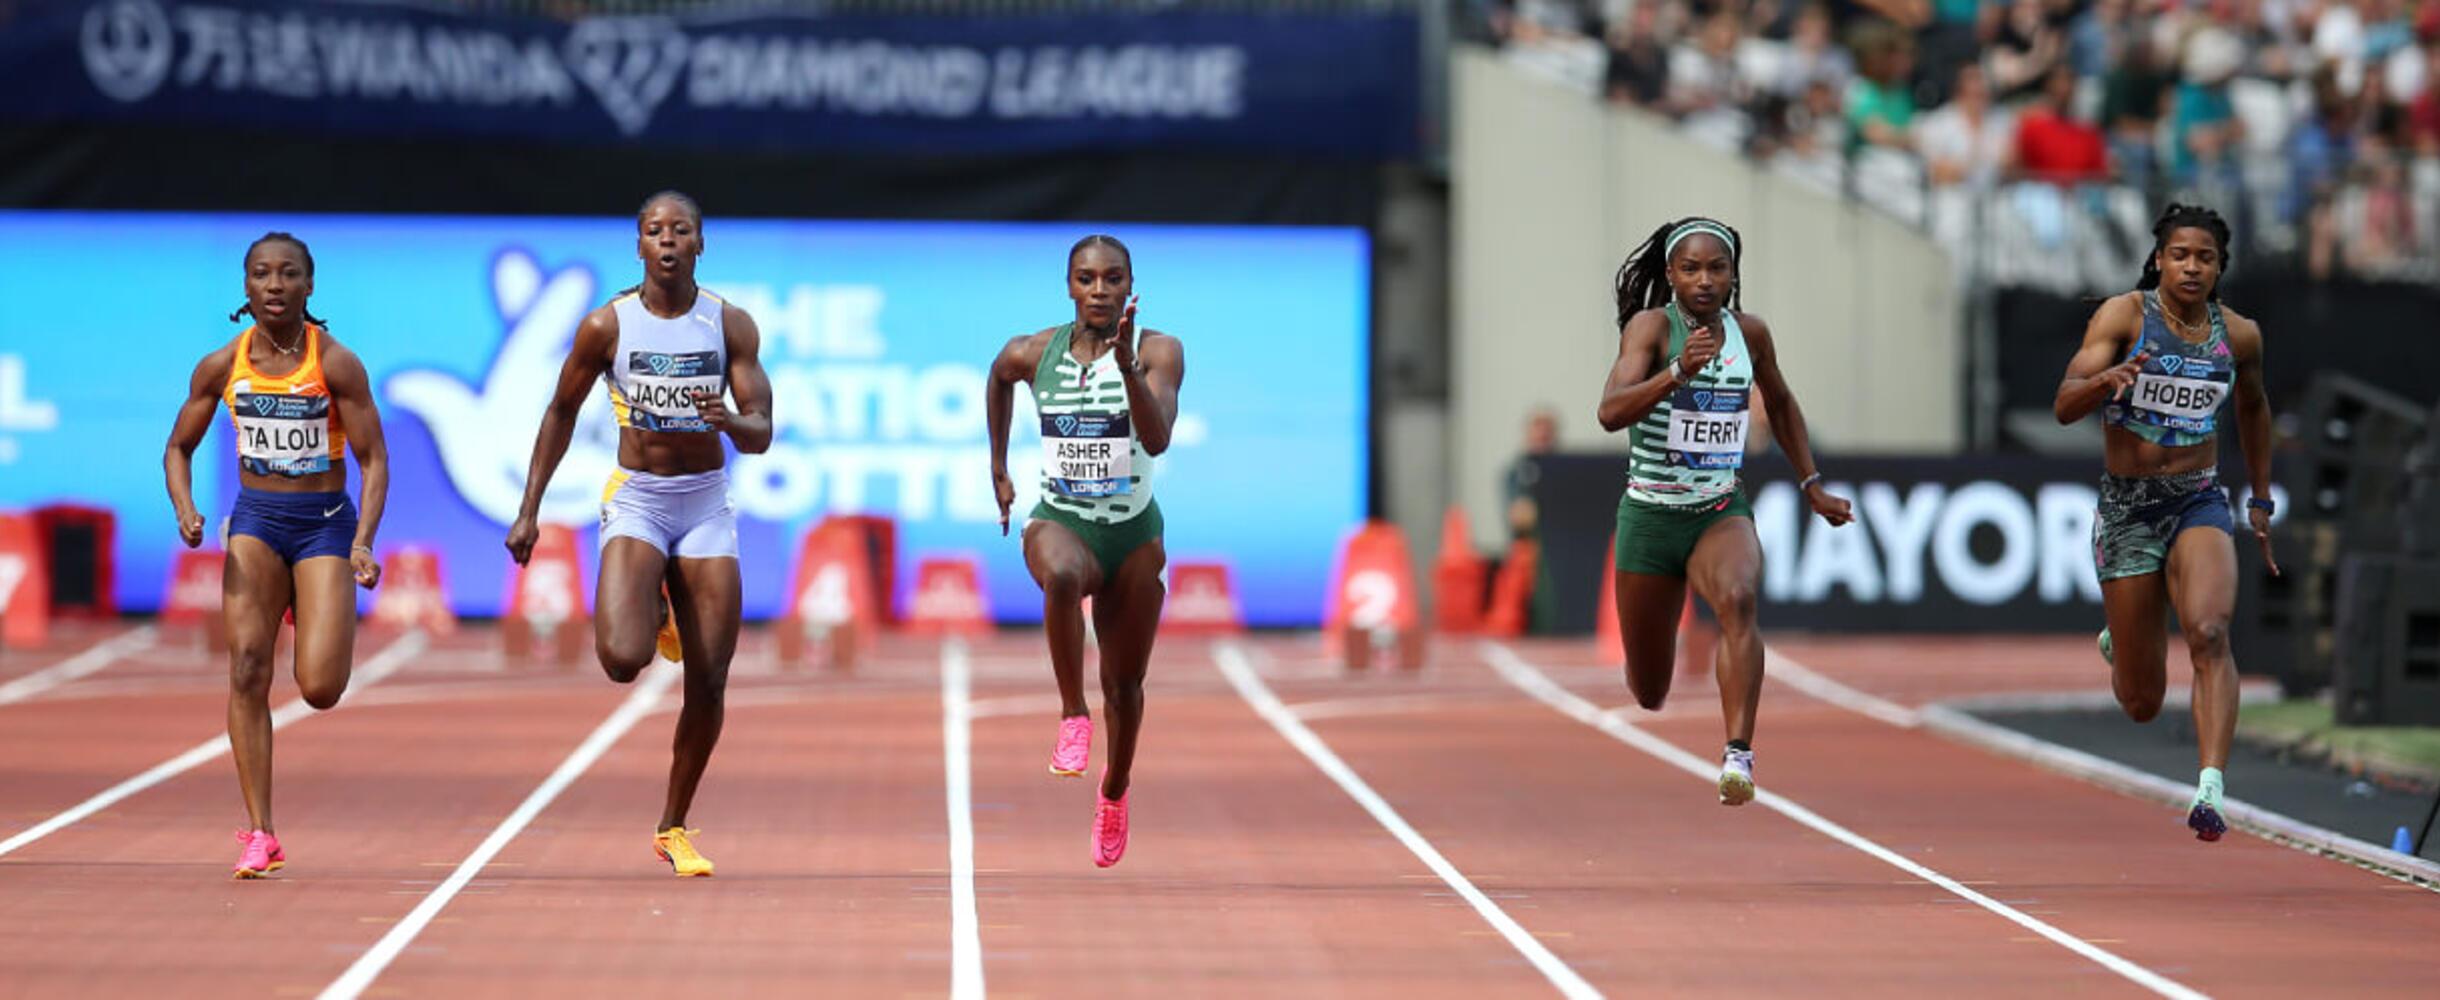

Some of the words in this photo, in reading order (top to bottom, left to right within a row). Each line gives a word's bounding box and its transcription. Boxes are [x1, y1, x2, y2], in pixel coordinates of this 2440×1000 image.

[690, 35, 988, 117] DIAMOND
[991, 45, 1247, 119] LEAGUE
[2142, 381, 2218, 410] HOBBS
[661, 418, 705, 430] LONDO
[1681, 418, 1742, 445] TERRY
[243, 425, 269, 449] TA
[274, 426, 320, 451] LOU
[1056, 442, 1112, 460] ASHER
[1060, 461, 1110, 478] SMITH
[1346, 568, 1400, 629] 2
